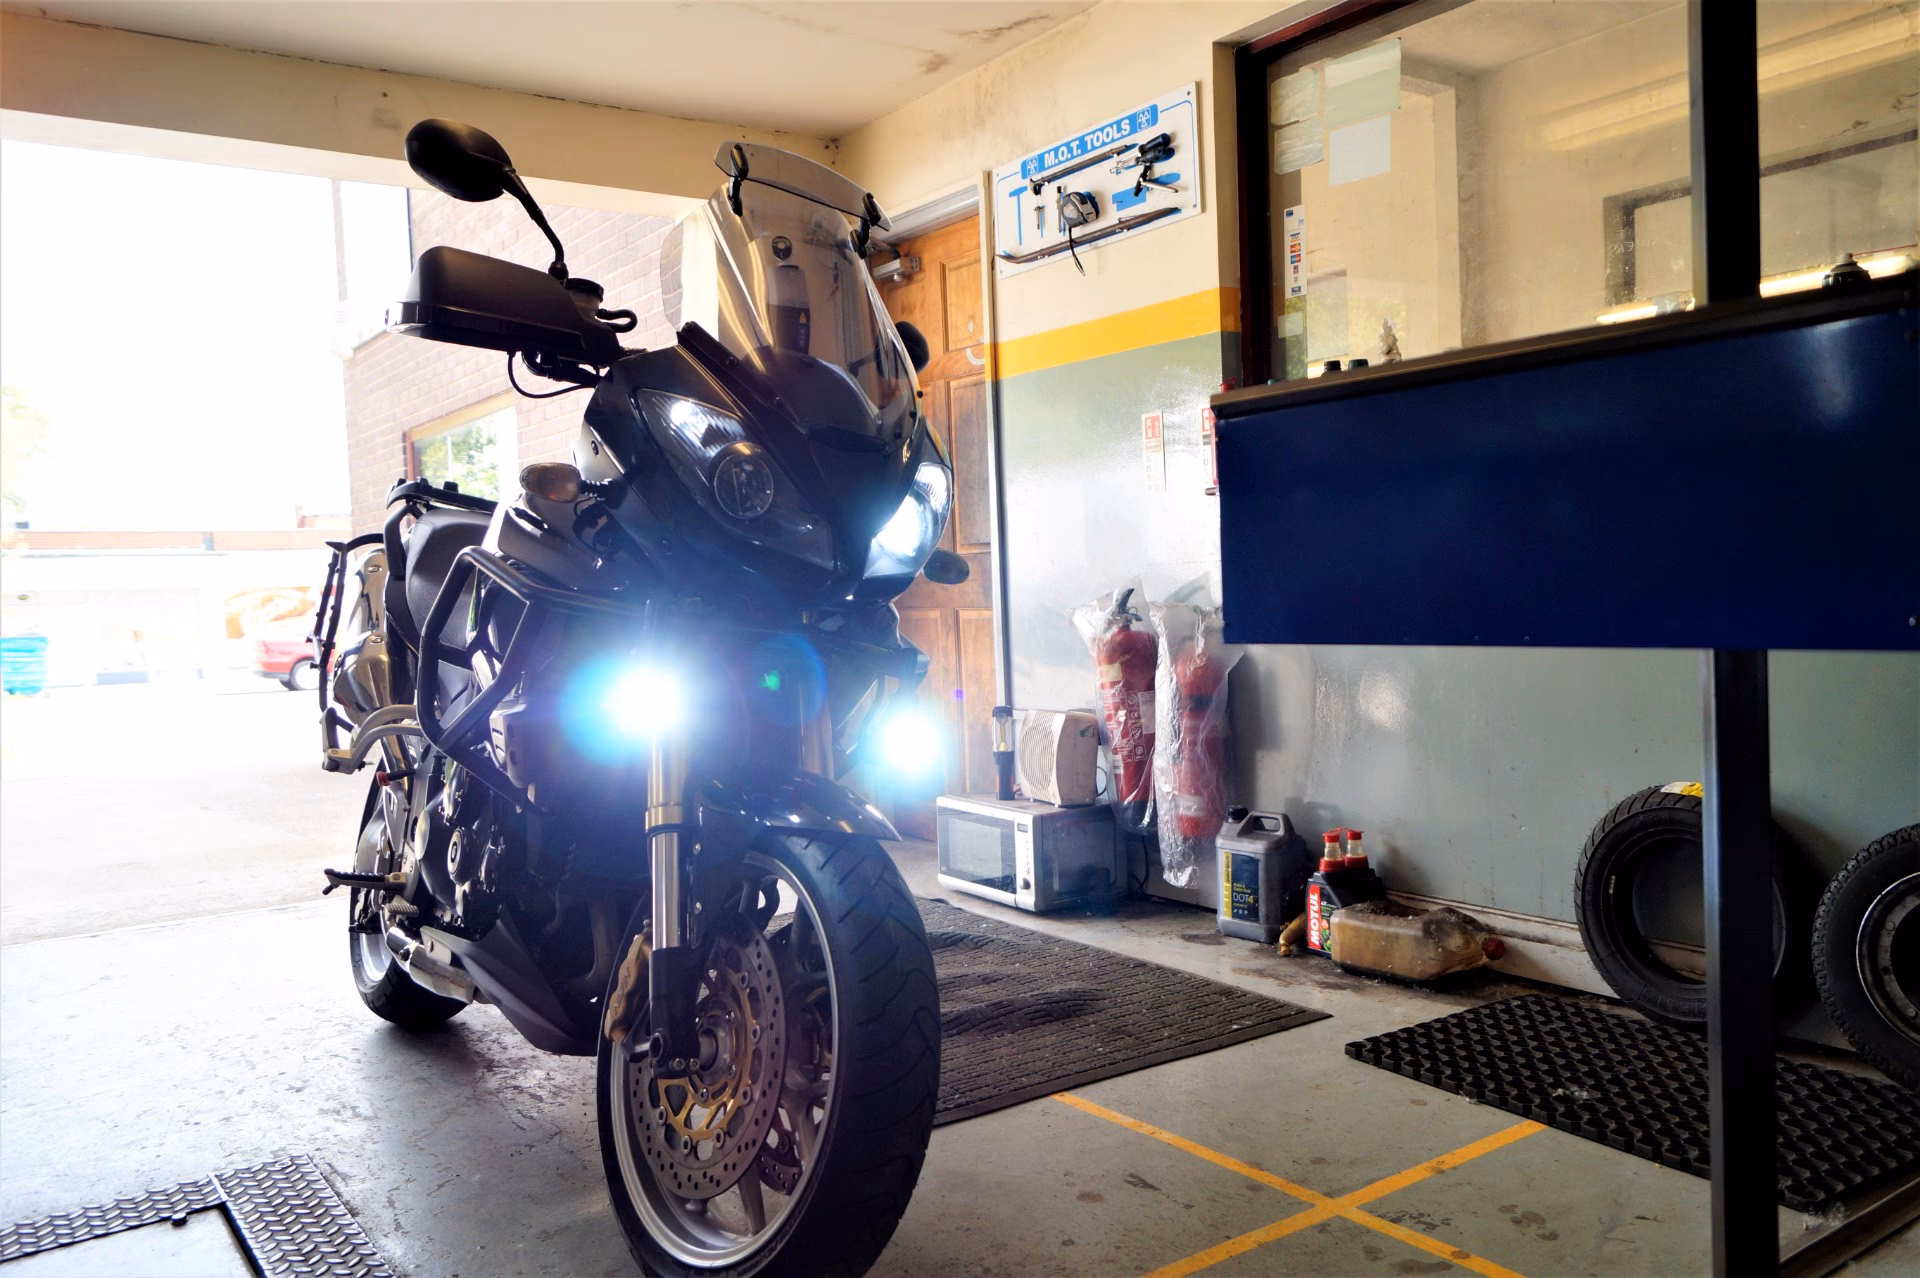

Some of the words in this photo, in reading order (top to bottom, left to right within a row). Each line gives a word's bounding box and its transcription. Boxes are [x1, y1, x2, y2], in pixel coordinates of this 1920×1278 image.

[1044, 140, 1081, 168] M.O.T.
[1085, 119, 1130, 150] TOOLS
[1310, 893, 1320, 946] MOTUL
